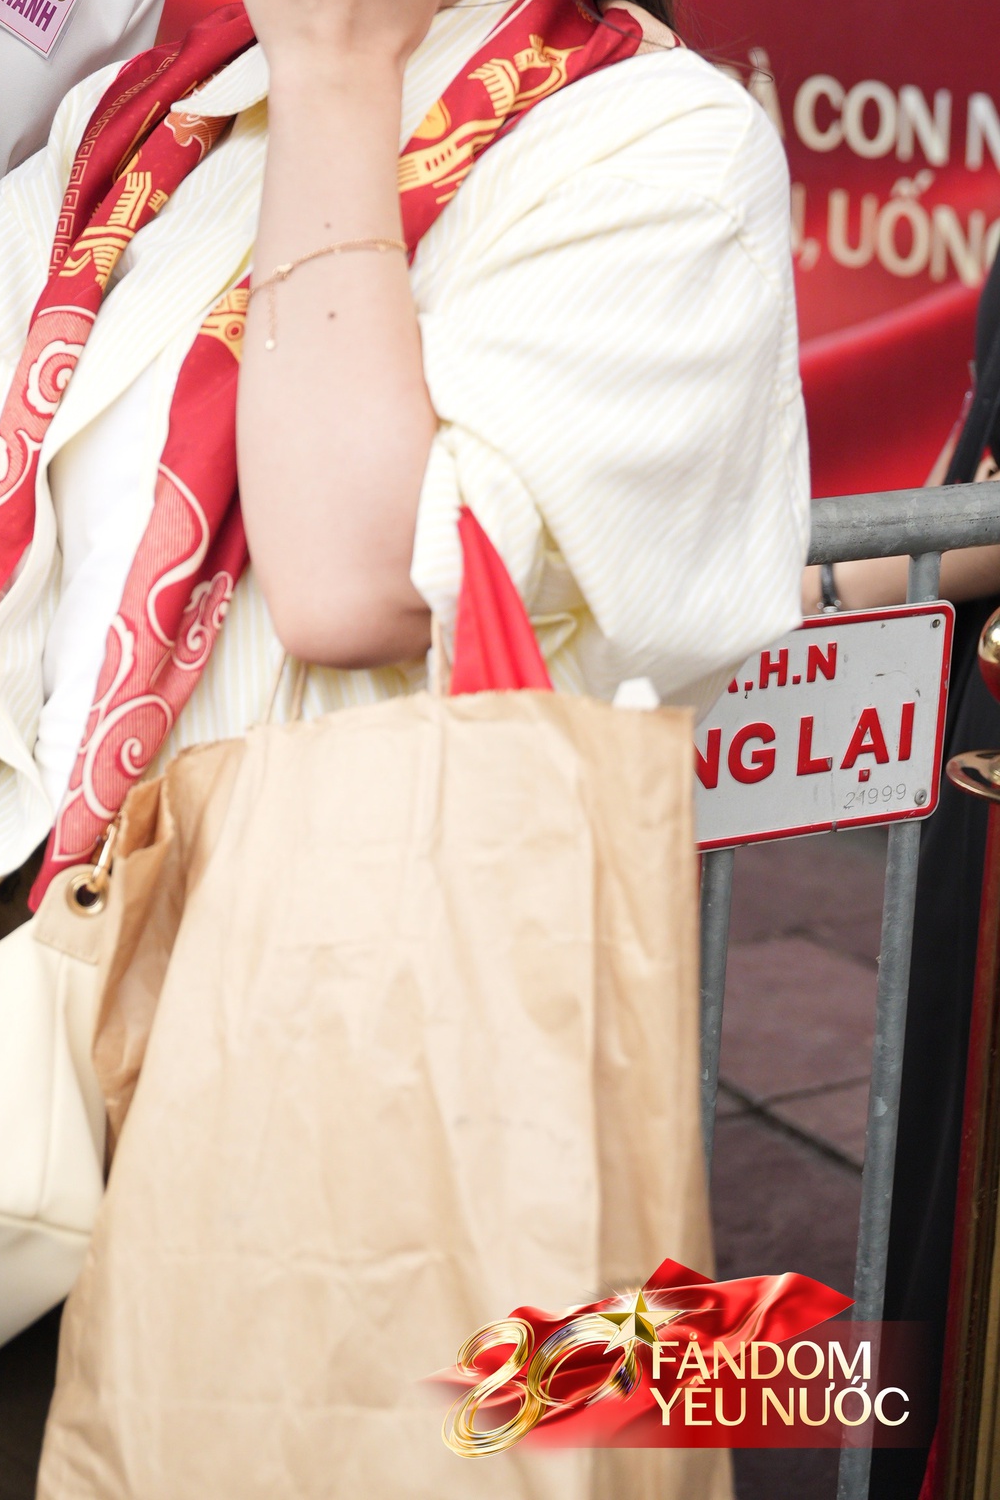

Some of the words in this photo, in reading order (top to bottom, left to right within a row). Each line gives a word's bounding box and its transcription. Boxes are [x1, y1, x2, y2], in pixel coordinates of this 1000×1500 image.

[794, 73, 952, 167] CON
[728, 641, 838, 693] .H.N
[796, 701, 916, 783] LẠI
[843, 783, 908, 811] 21999
